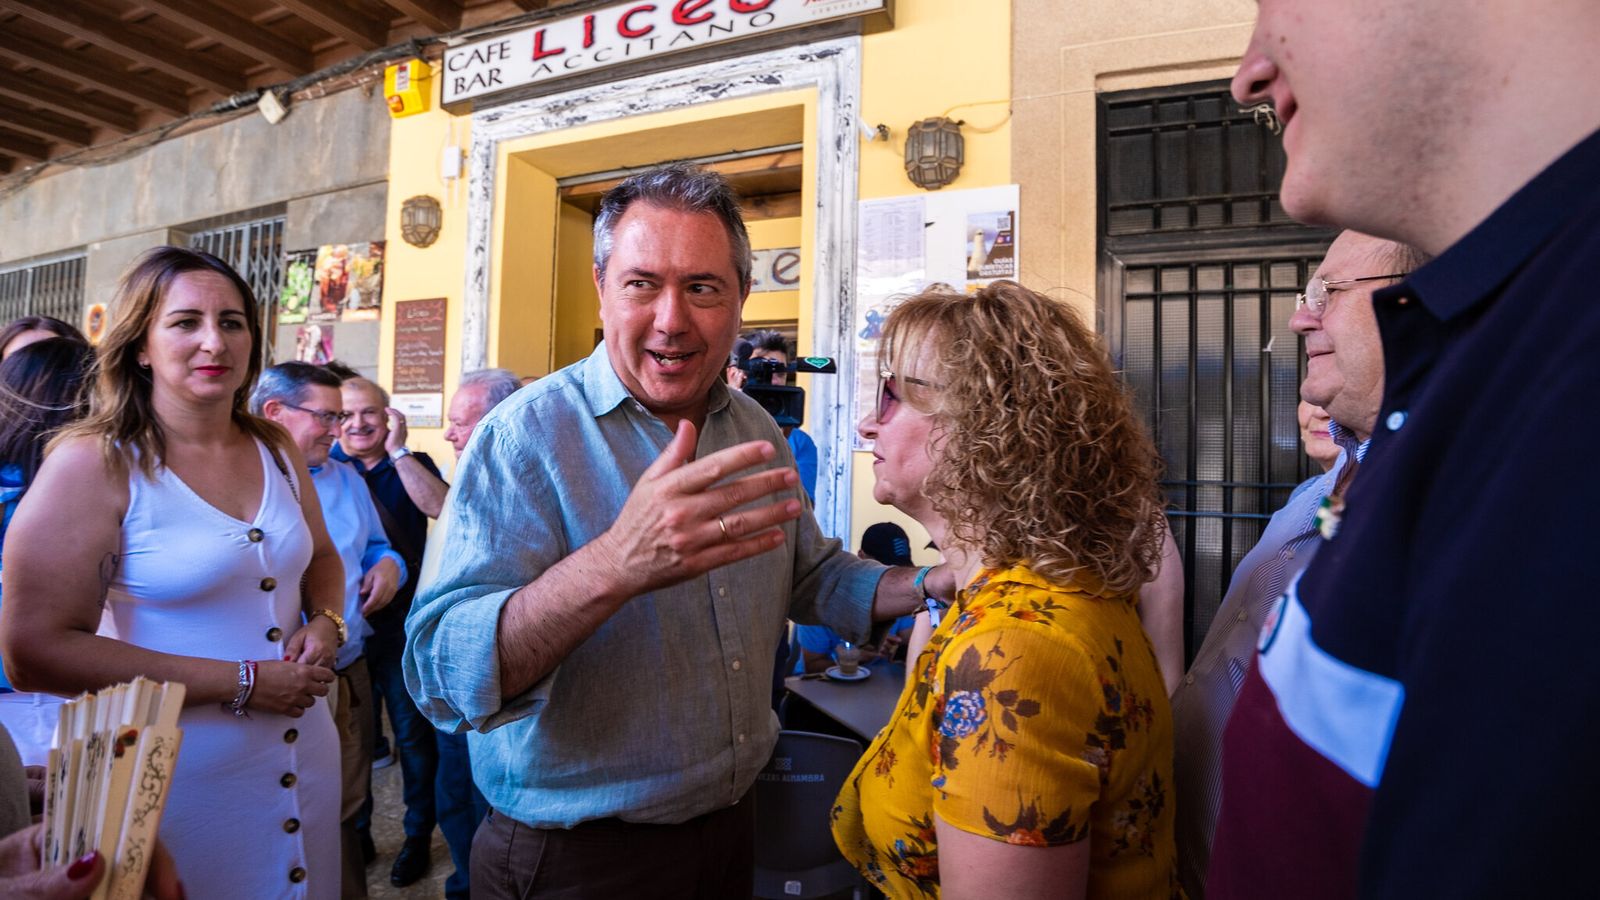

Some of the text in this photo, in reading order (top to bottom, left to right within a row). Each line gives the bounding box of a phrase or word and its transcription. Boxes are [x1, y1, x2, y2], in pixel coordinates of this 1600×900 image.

[448, 40, 511, 72] CAFE
[531, 12, 775, 78] ACCITANO
[454, 68, 503, 95] BAR
[782, 773, 825, 782] ALHAMBRA
